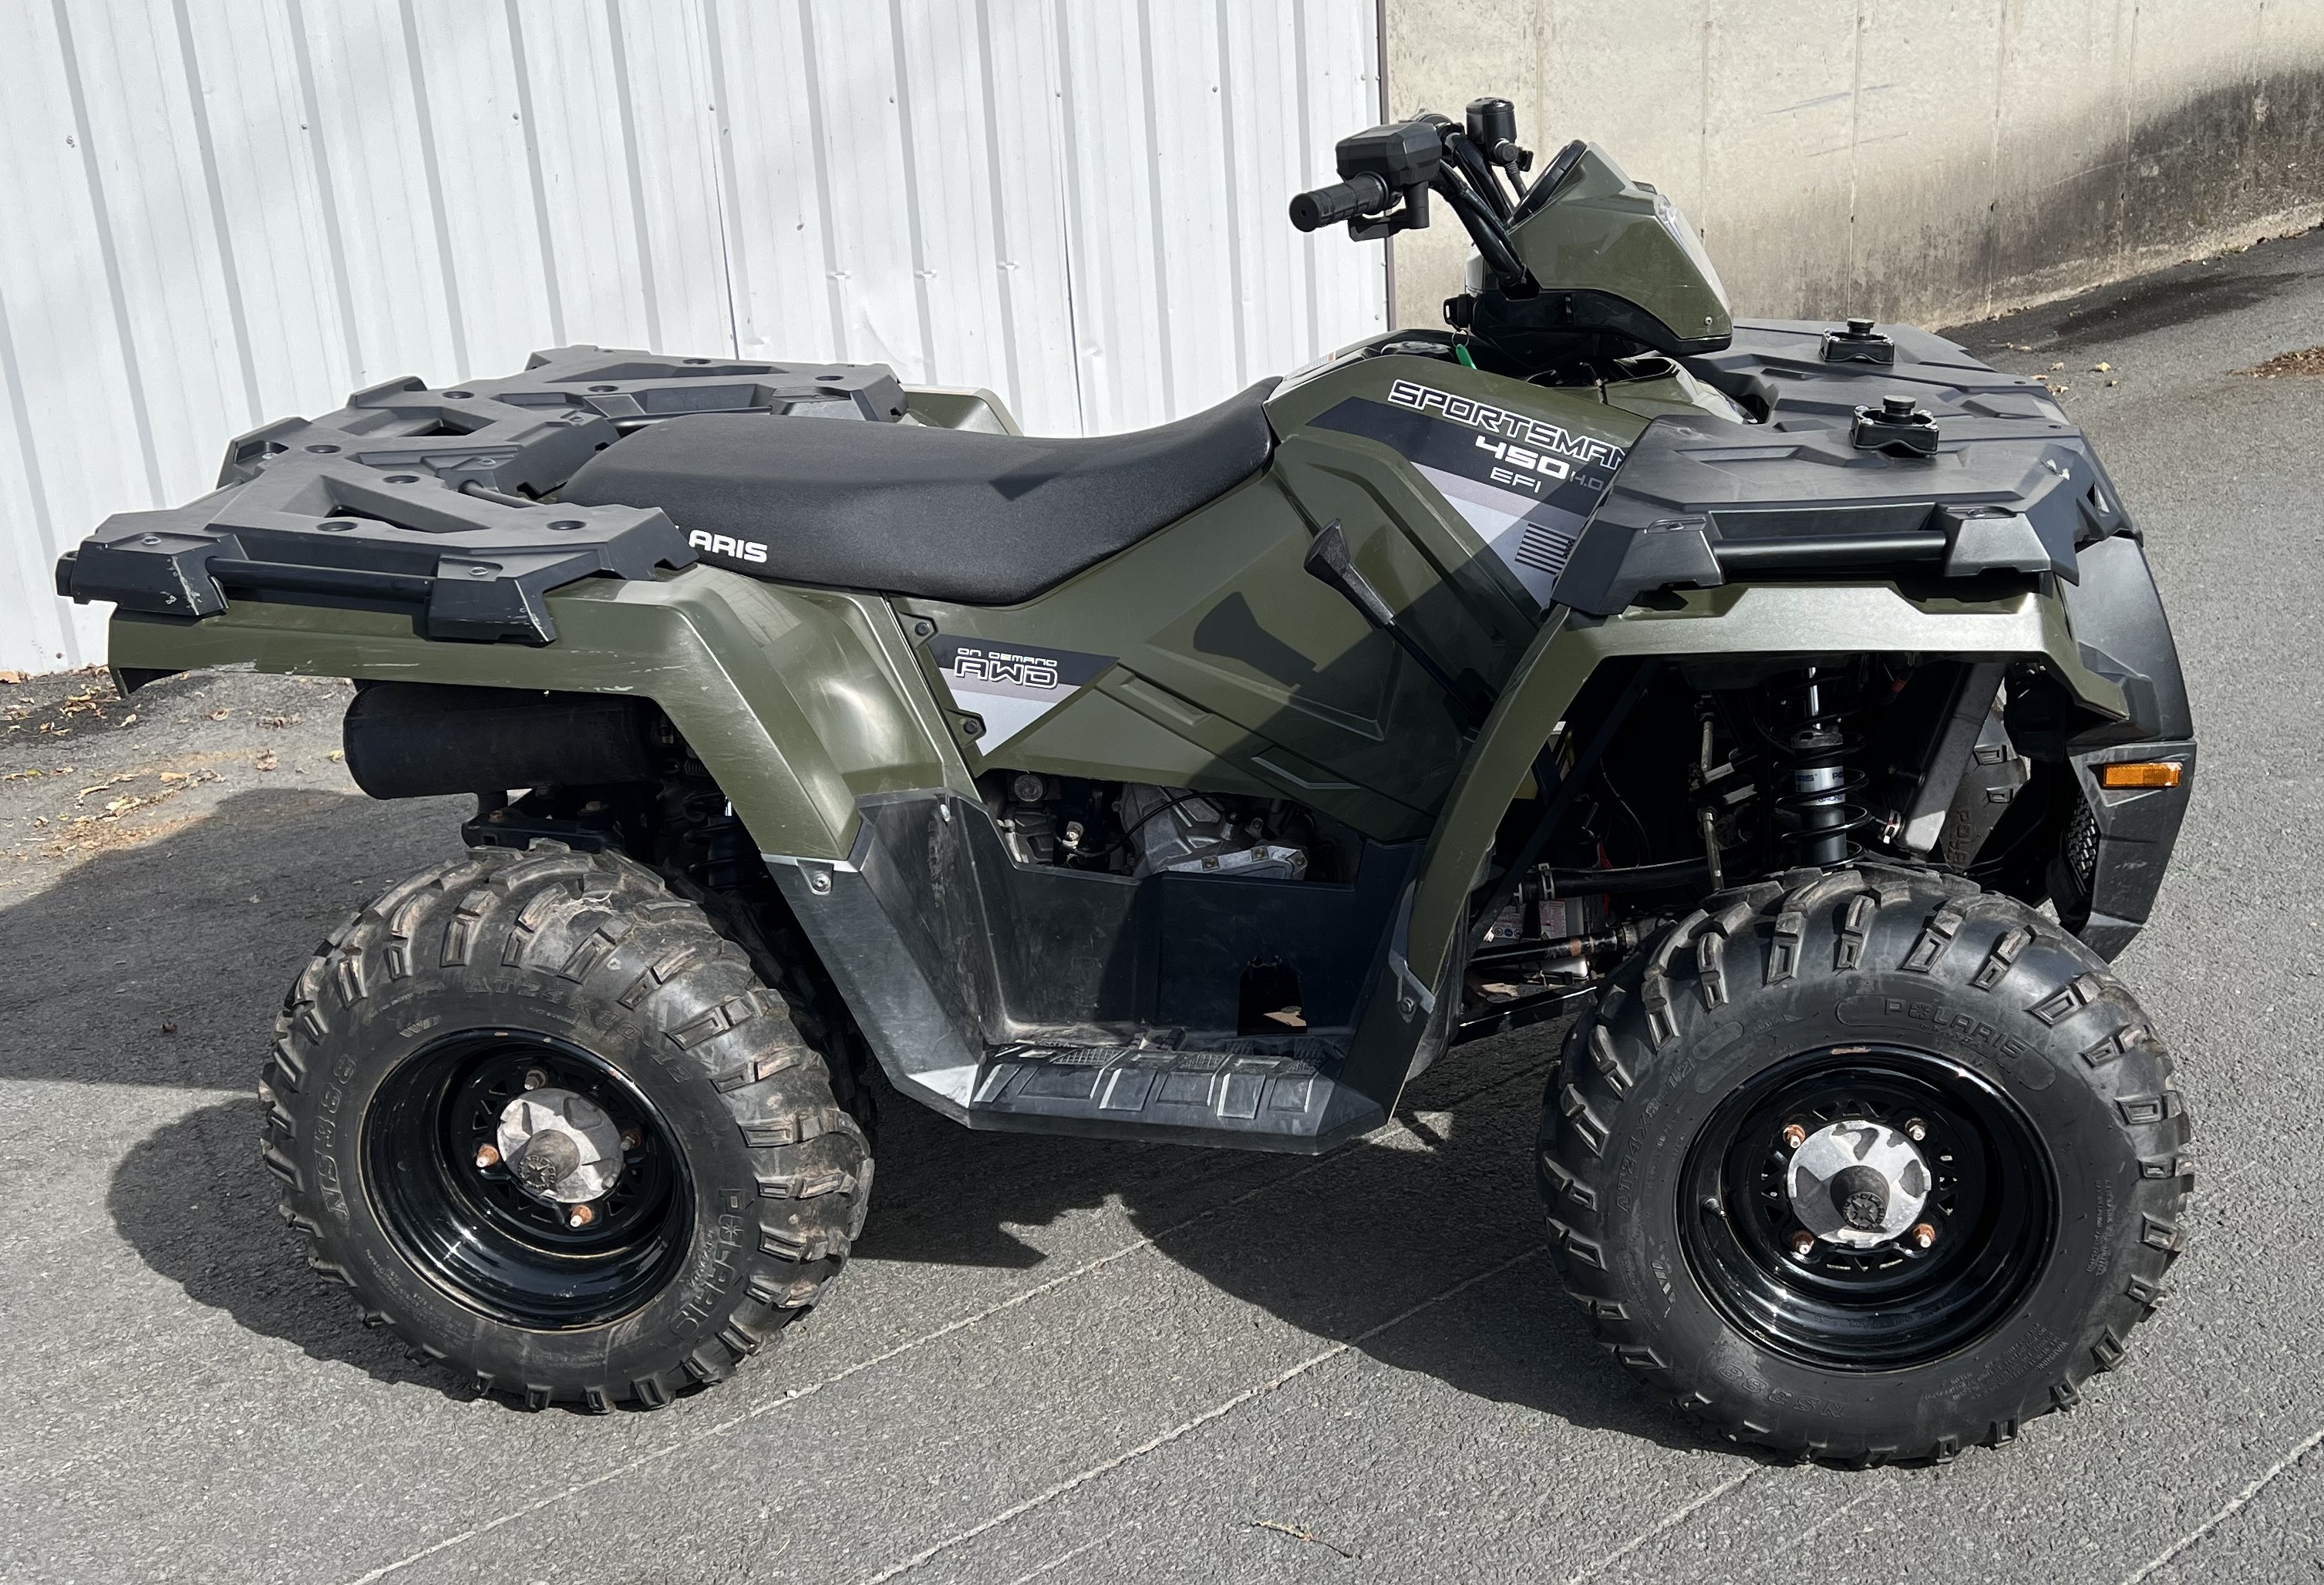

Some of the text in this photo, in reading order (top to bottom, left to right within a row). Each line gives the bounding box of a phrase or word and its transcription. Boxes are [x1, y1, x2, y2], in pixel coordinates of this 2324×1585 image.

[1476, 435, 1570, 480] 450
[1490, 466, 1541, 493] EFI
[689, 530, 768, 563] ARIS
[954, 656, 1058, 688] AWD
[989, 651, 1057, 667] DEMAND
[1884, 998, 2027, 1059] POLARIS
[669, 1188, 744, 1340] POLARIS
